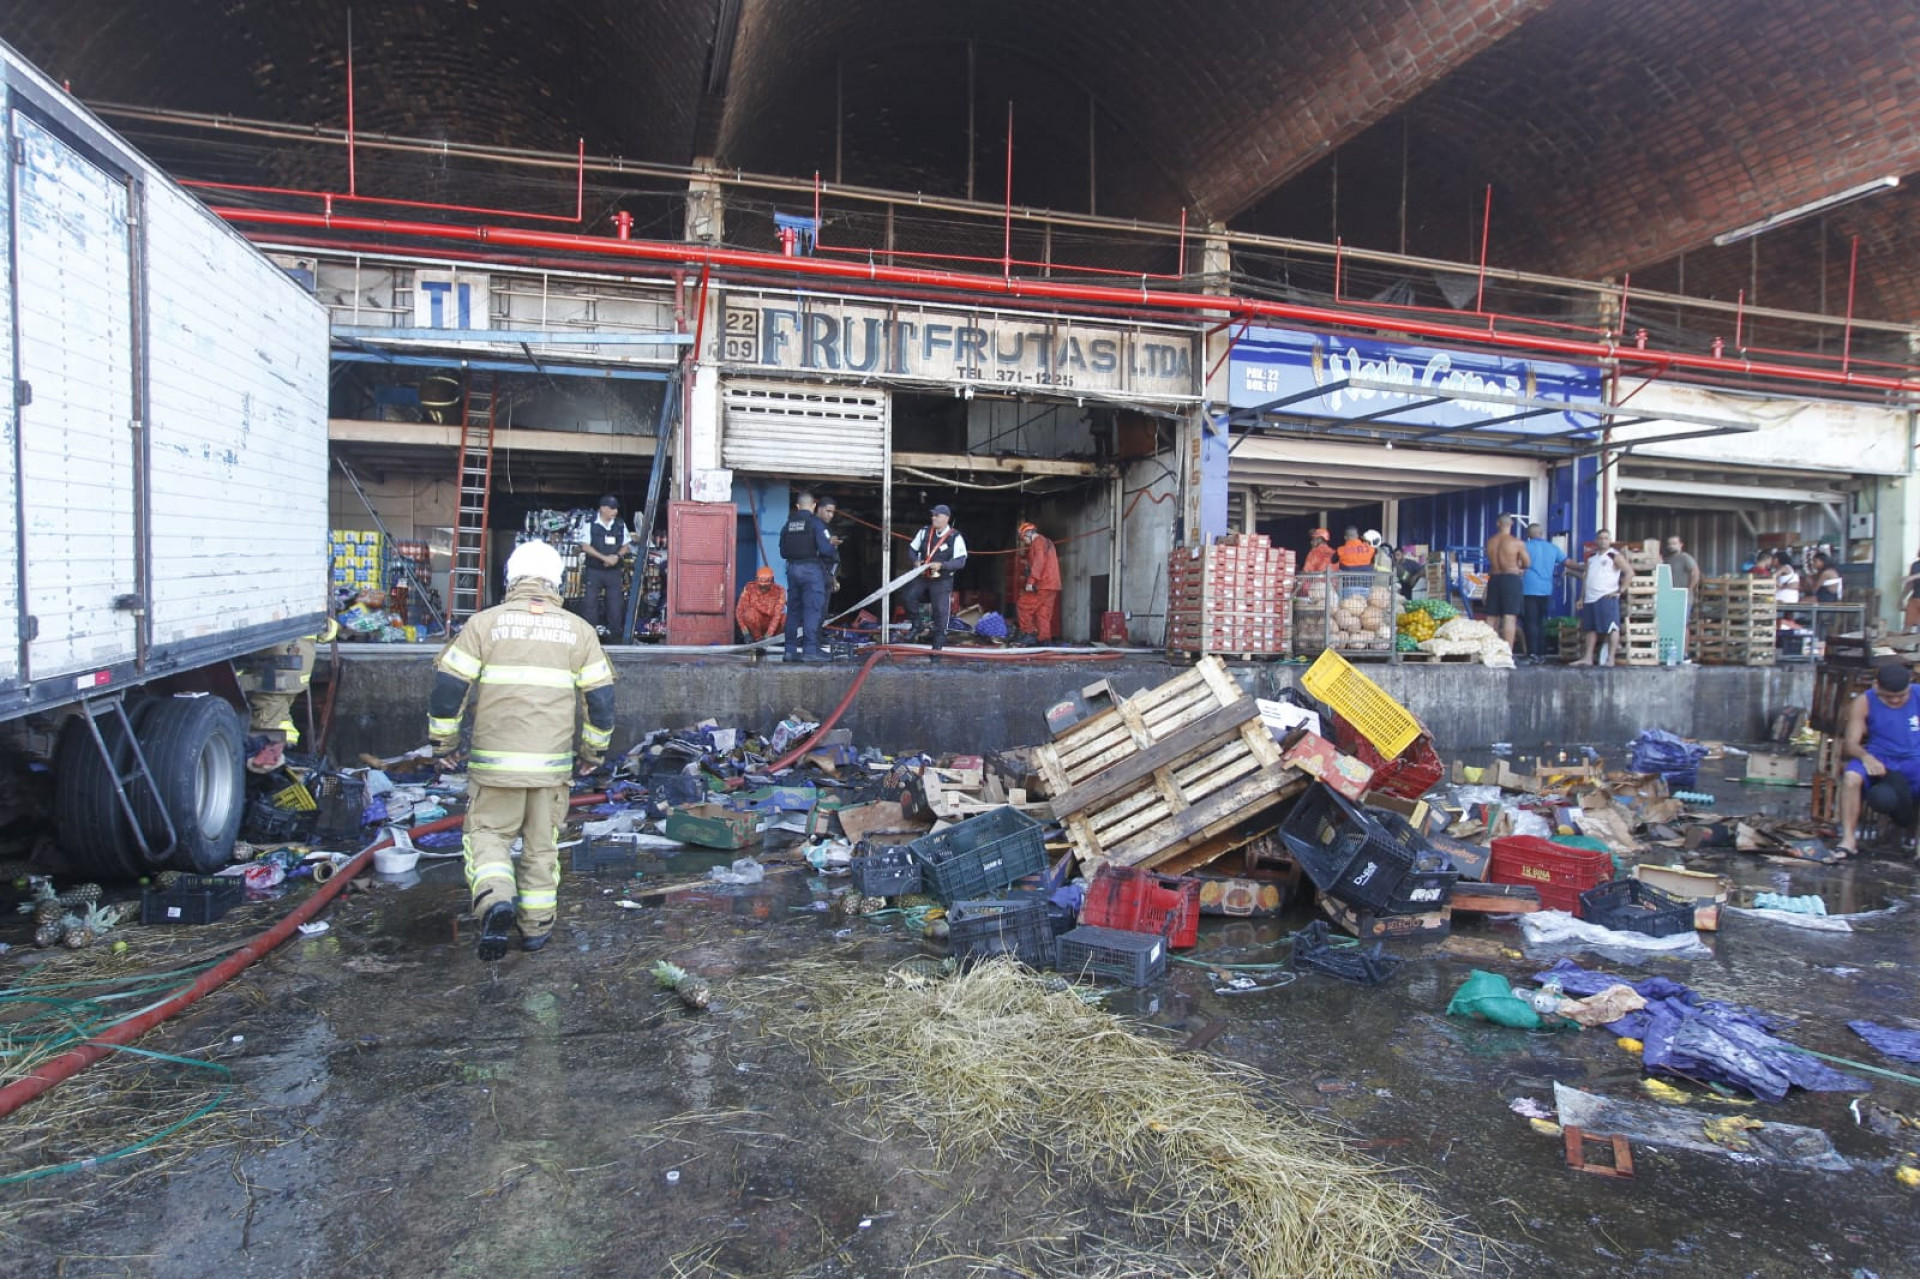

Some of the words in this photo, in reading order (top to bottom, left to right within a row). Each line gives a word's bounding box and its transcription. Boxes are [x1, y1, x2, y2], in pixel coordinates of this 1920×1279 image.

[726, 312, 754, 331] 22
[726, 340, 753, 358] 09
[1128, 342, 1192, 379] LTDA
[1267, 368, 1279, 381] 22
[497, 613, 572, 630] BOMBEIROS
[511, 626, 528, 639] DE
[529, 628, 577, 646] JANEIRO
